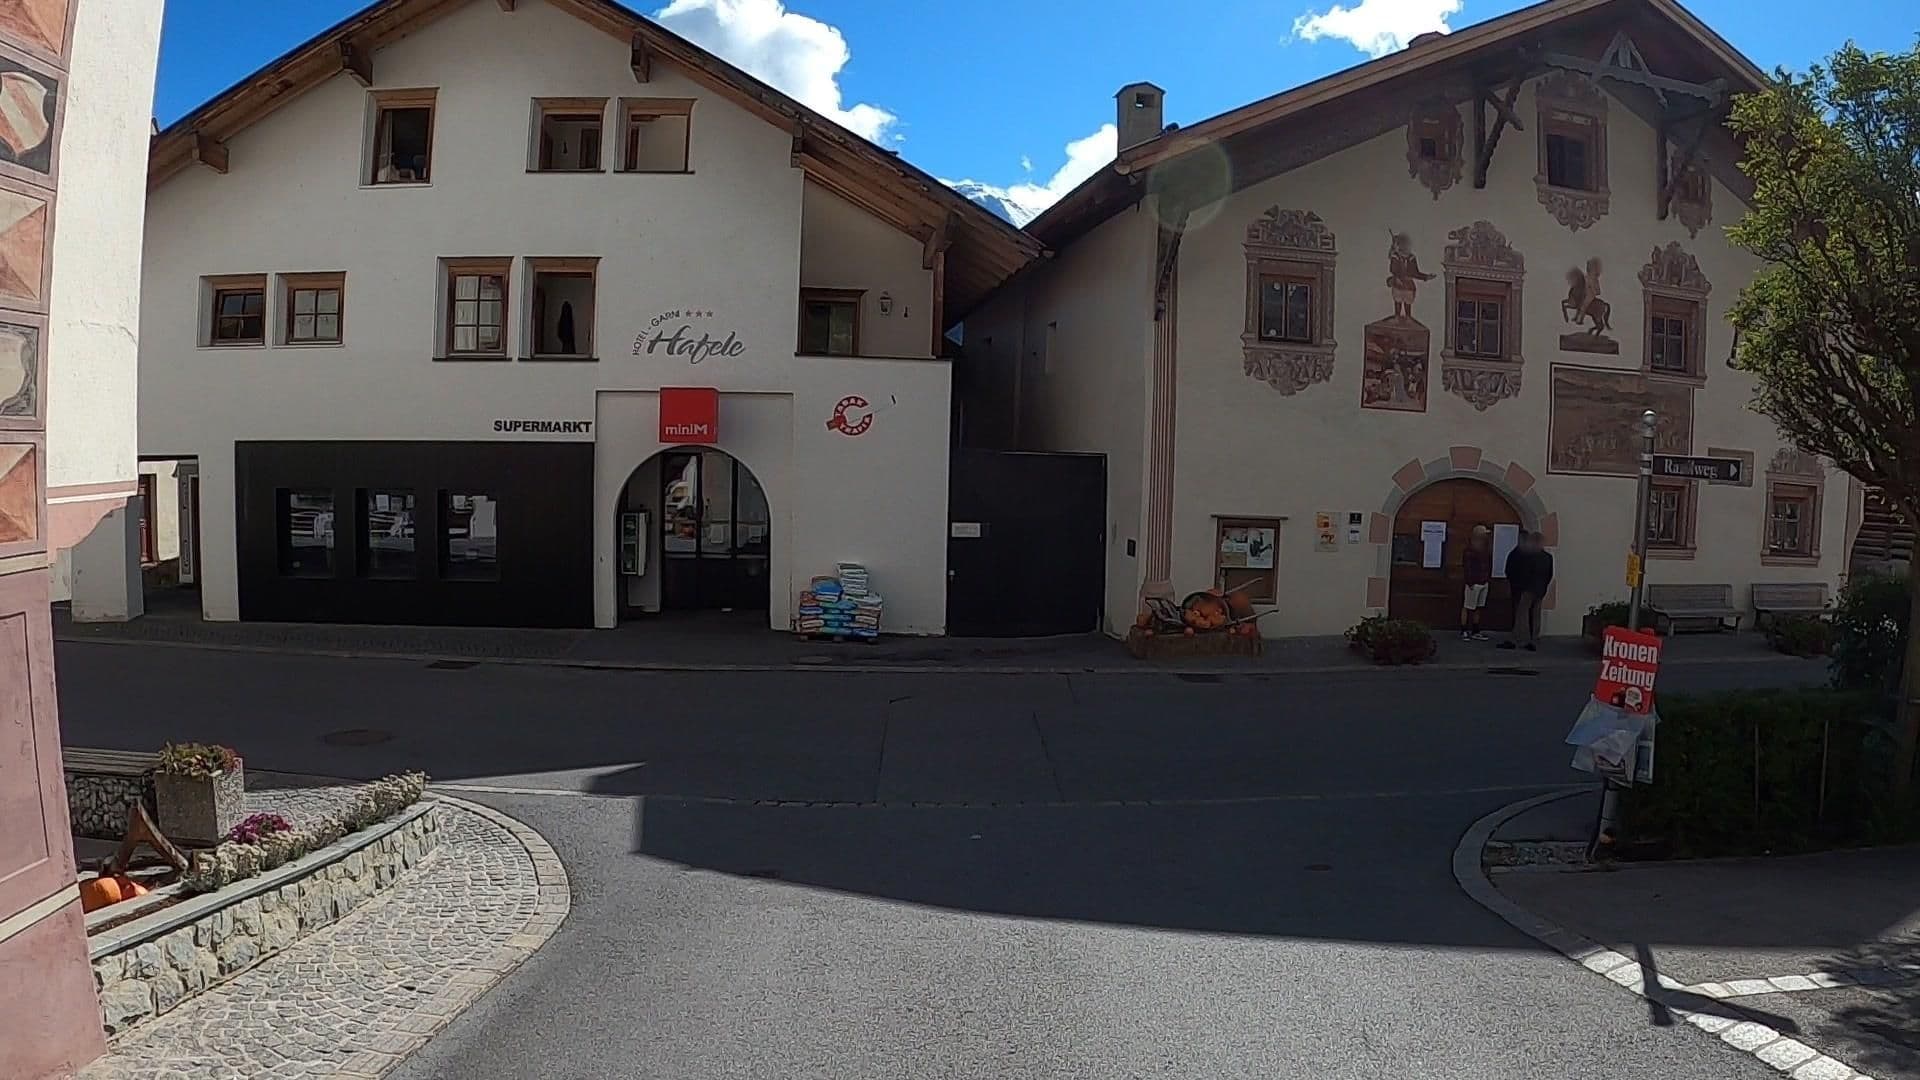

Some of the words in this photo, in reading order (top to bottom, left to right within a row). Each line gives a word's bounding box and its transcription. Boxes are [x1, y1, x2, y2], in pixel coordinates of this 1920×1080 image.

[493, 420, 593, 433] SUPERMARKT
[1664, 458, 1718, 479] Ralweg
[1602, 635, 1658, 664] Kronen
[1600, 660, 1656, 691] Zeitung
